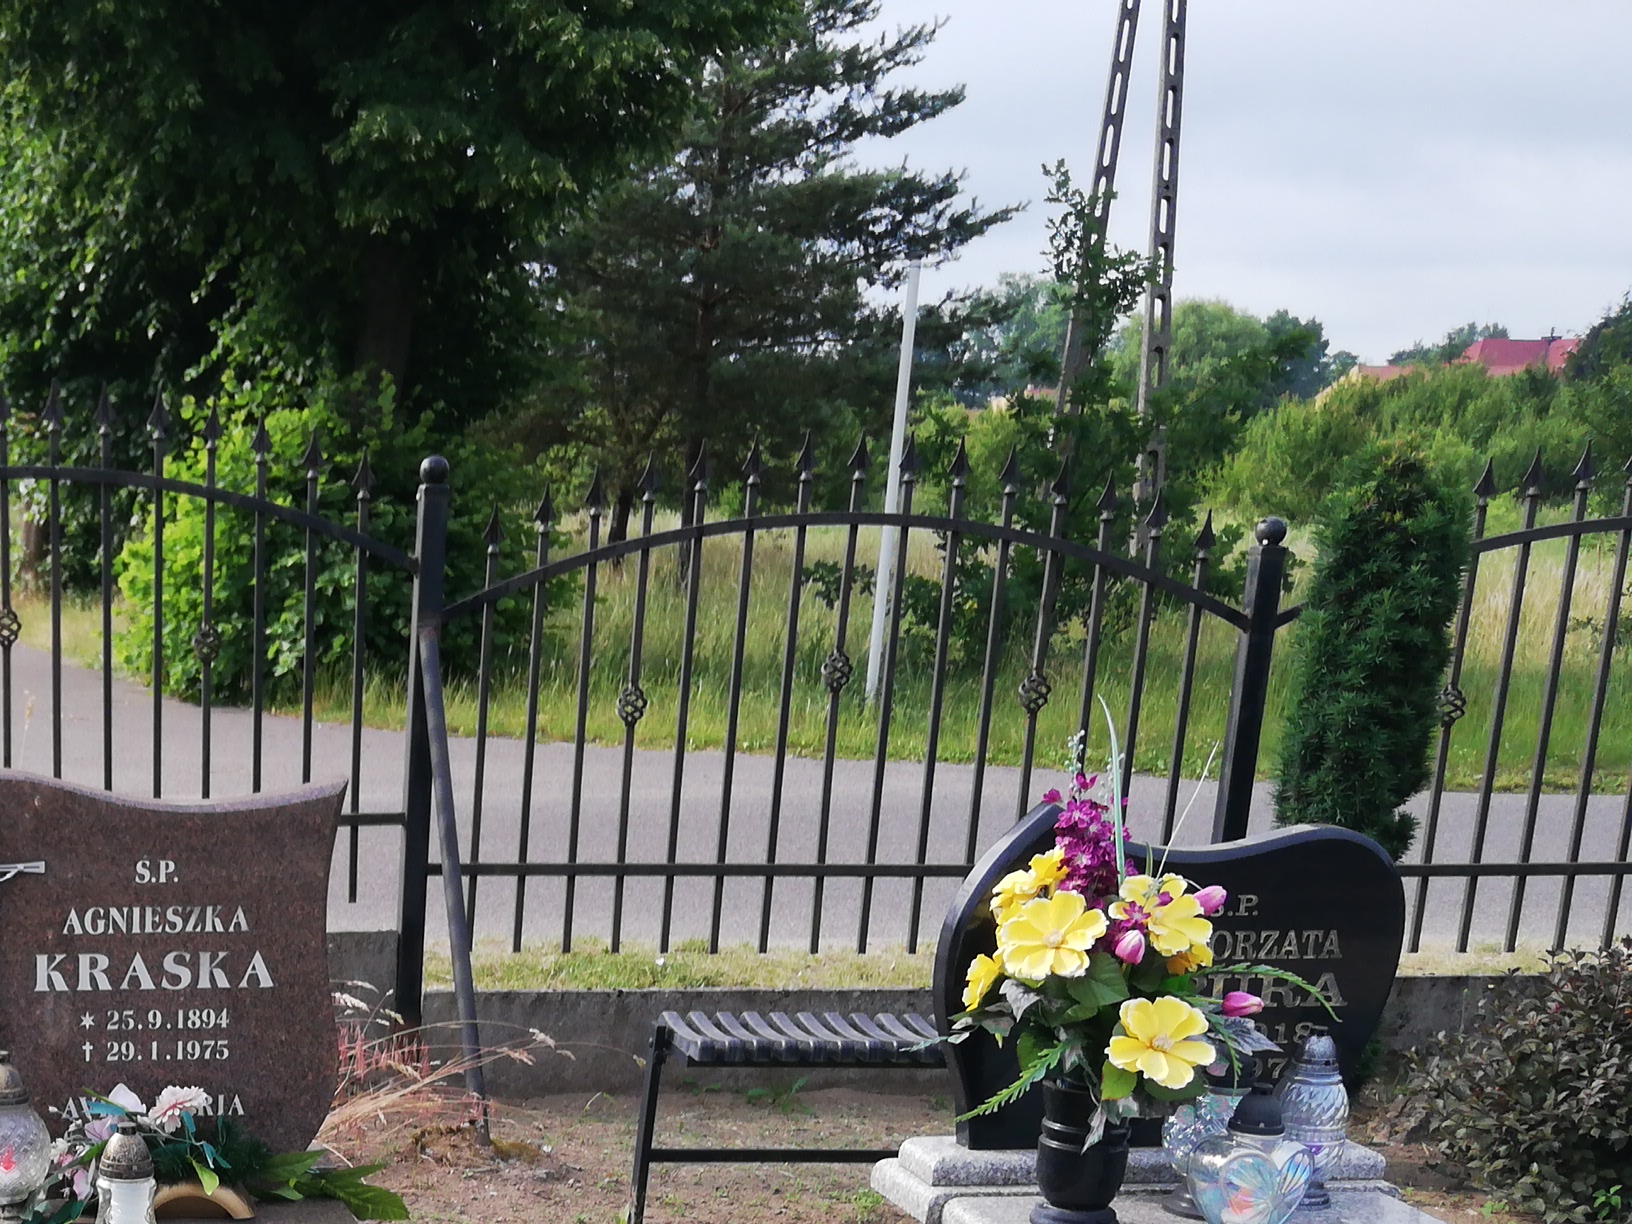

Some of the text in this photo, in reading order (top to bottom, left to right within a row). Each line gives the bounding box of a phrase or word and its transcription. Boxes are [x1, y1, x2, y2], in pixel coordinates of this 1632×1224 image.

[62, 904, 250, 935] AGNIESZKA
[1206, 928, 1344, 961] ORZATA
[33, 949, 275, 993] KRASKA
[154, 1093, 246, 1118] RIA
